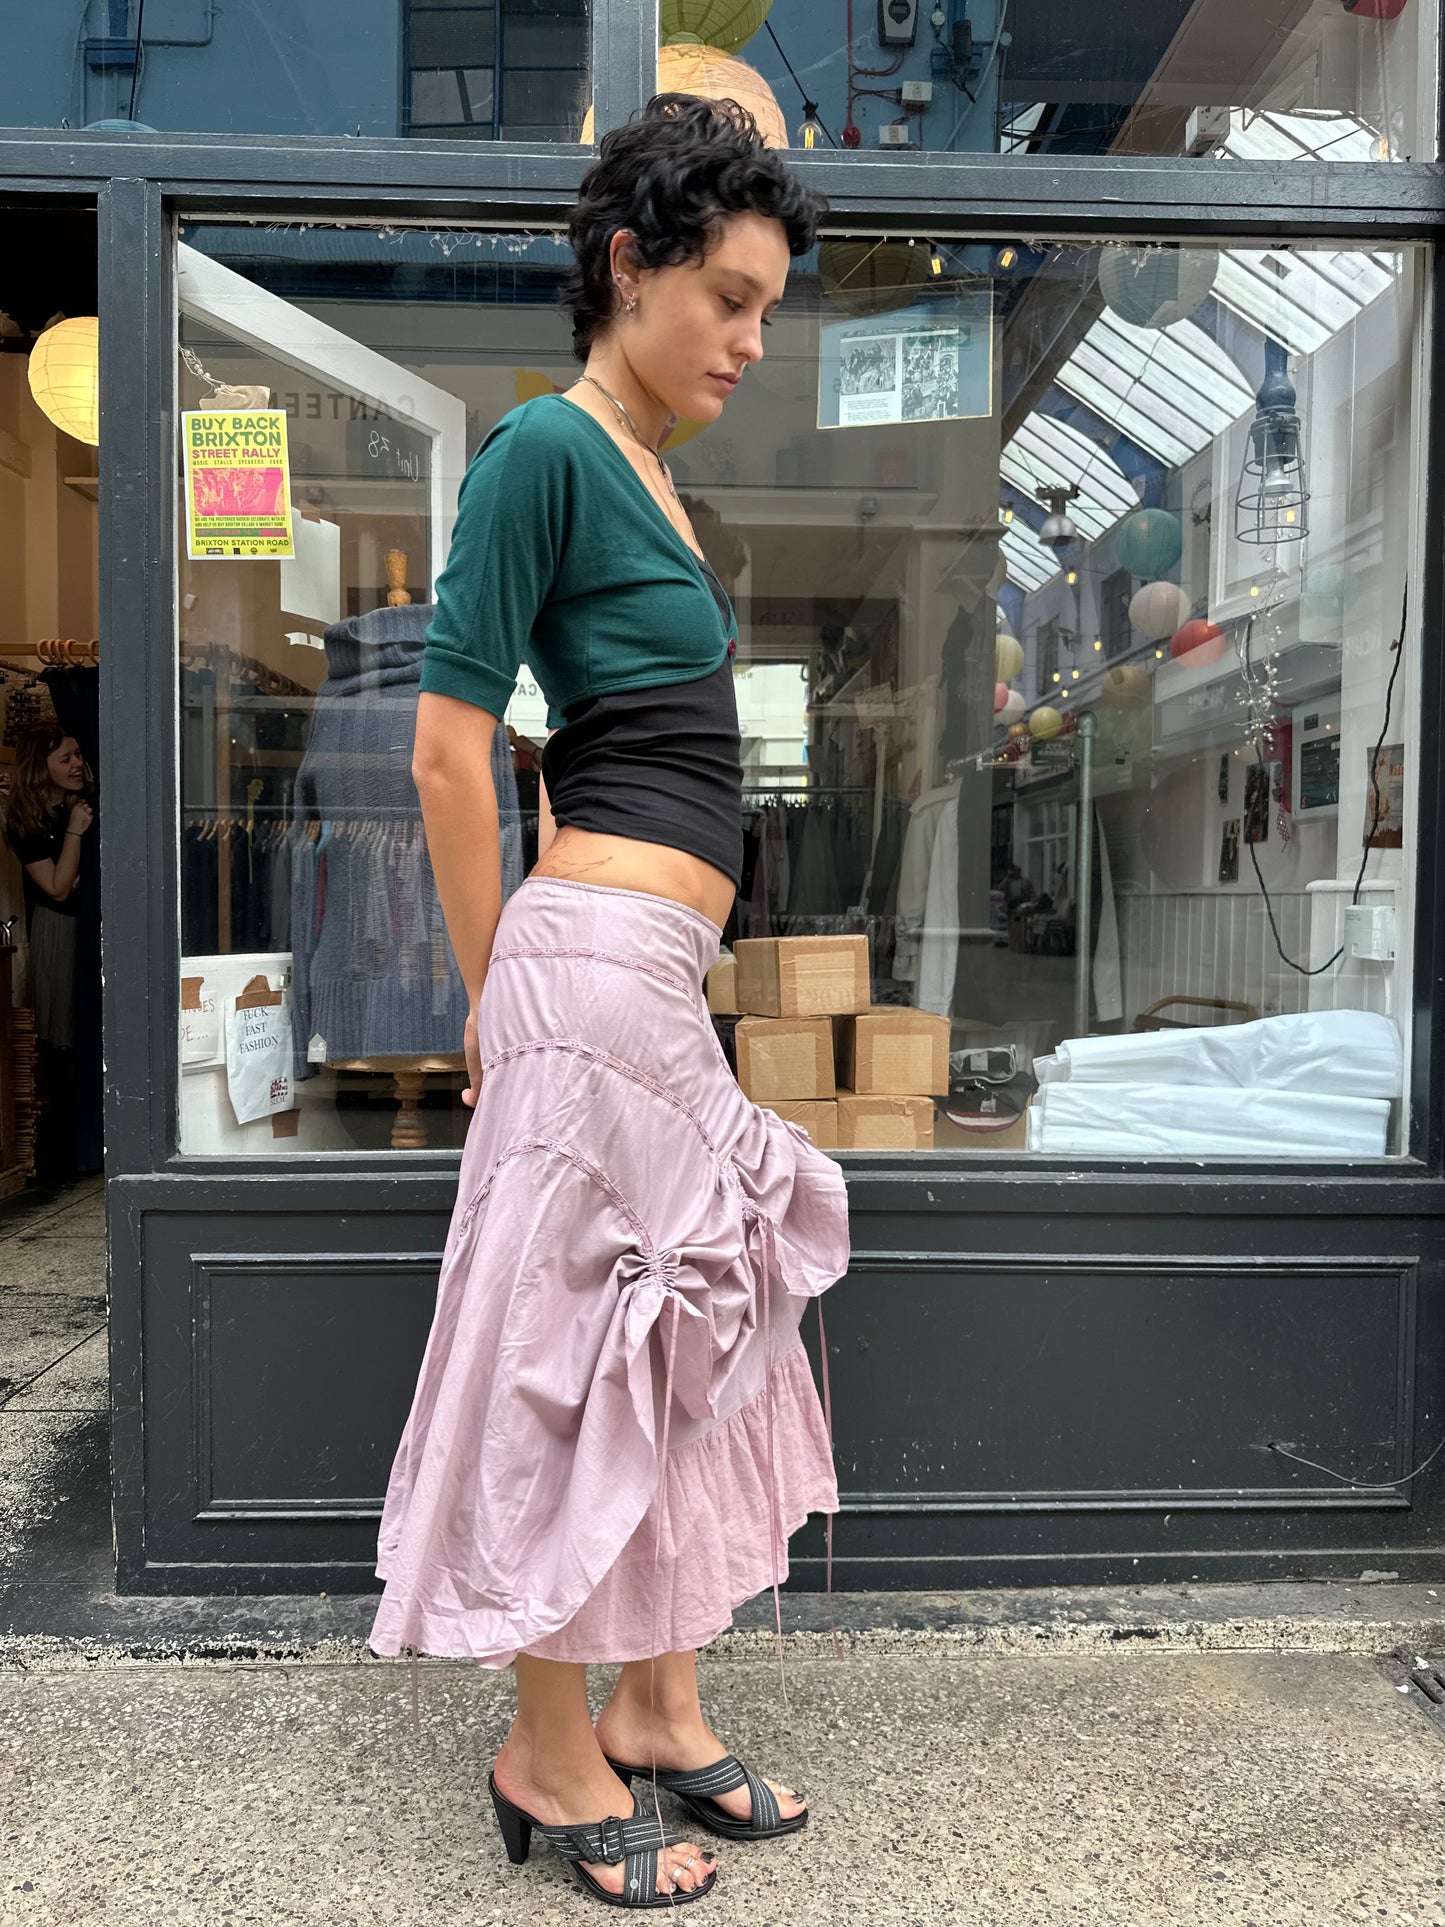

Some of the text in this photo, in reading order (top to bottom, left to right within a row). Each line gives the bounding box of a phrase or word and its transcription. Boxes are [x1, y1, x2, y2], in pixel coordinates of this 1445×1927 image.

[191, 416, 280, 431] BUY BACK
[192, 430, 282, 447] BRIXTON
[192, 447, 281, 459] STREET RALLY
[243, 1006, 270, 1021] FUCK
[245, 1021, 267, 1036] FAST
[239, 1034, 279, 1054] FASHION
